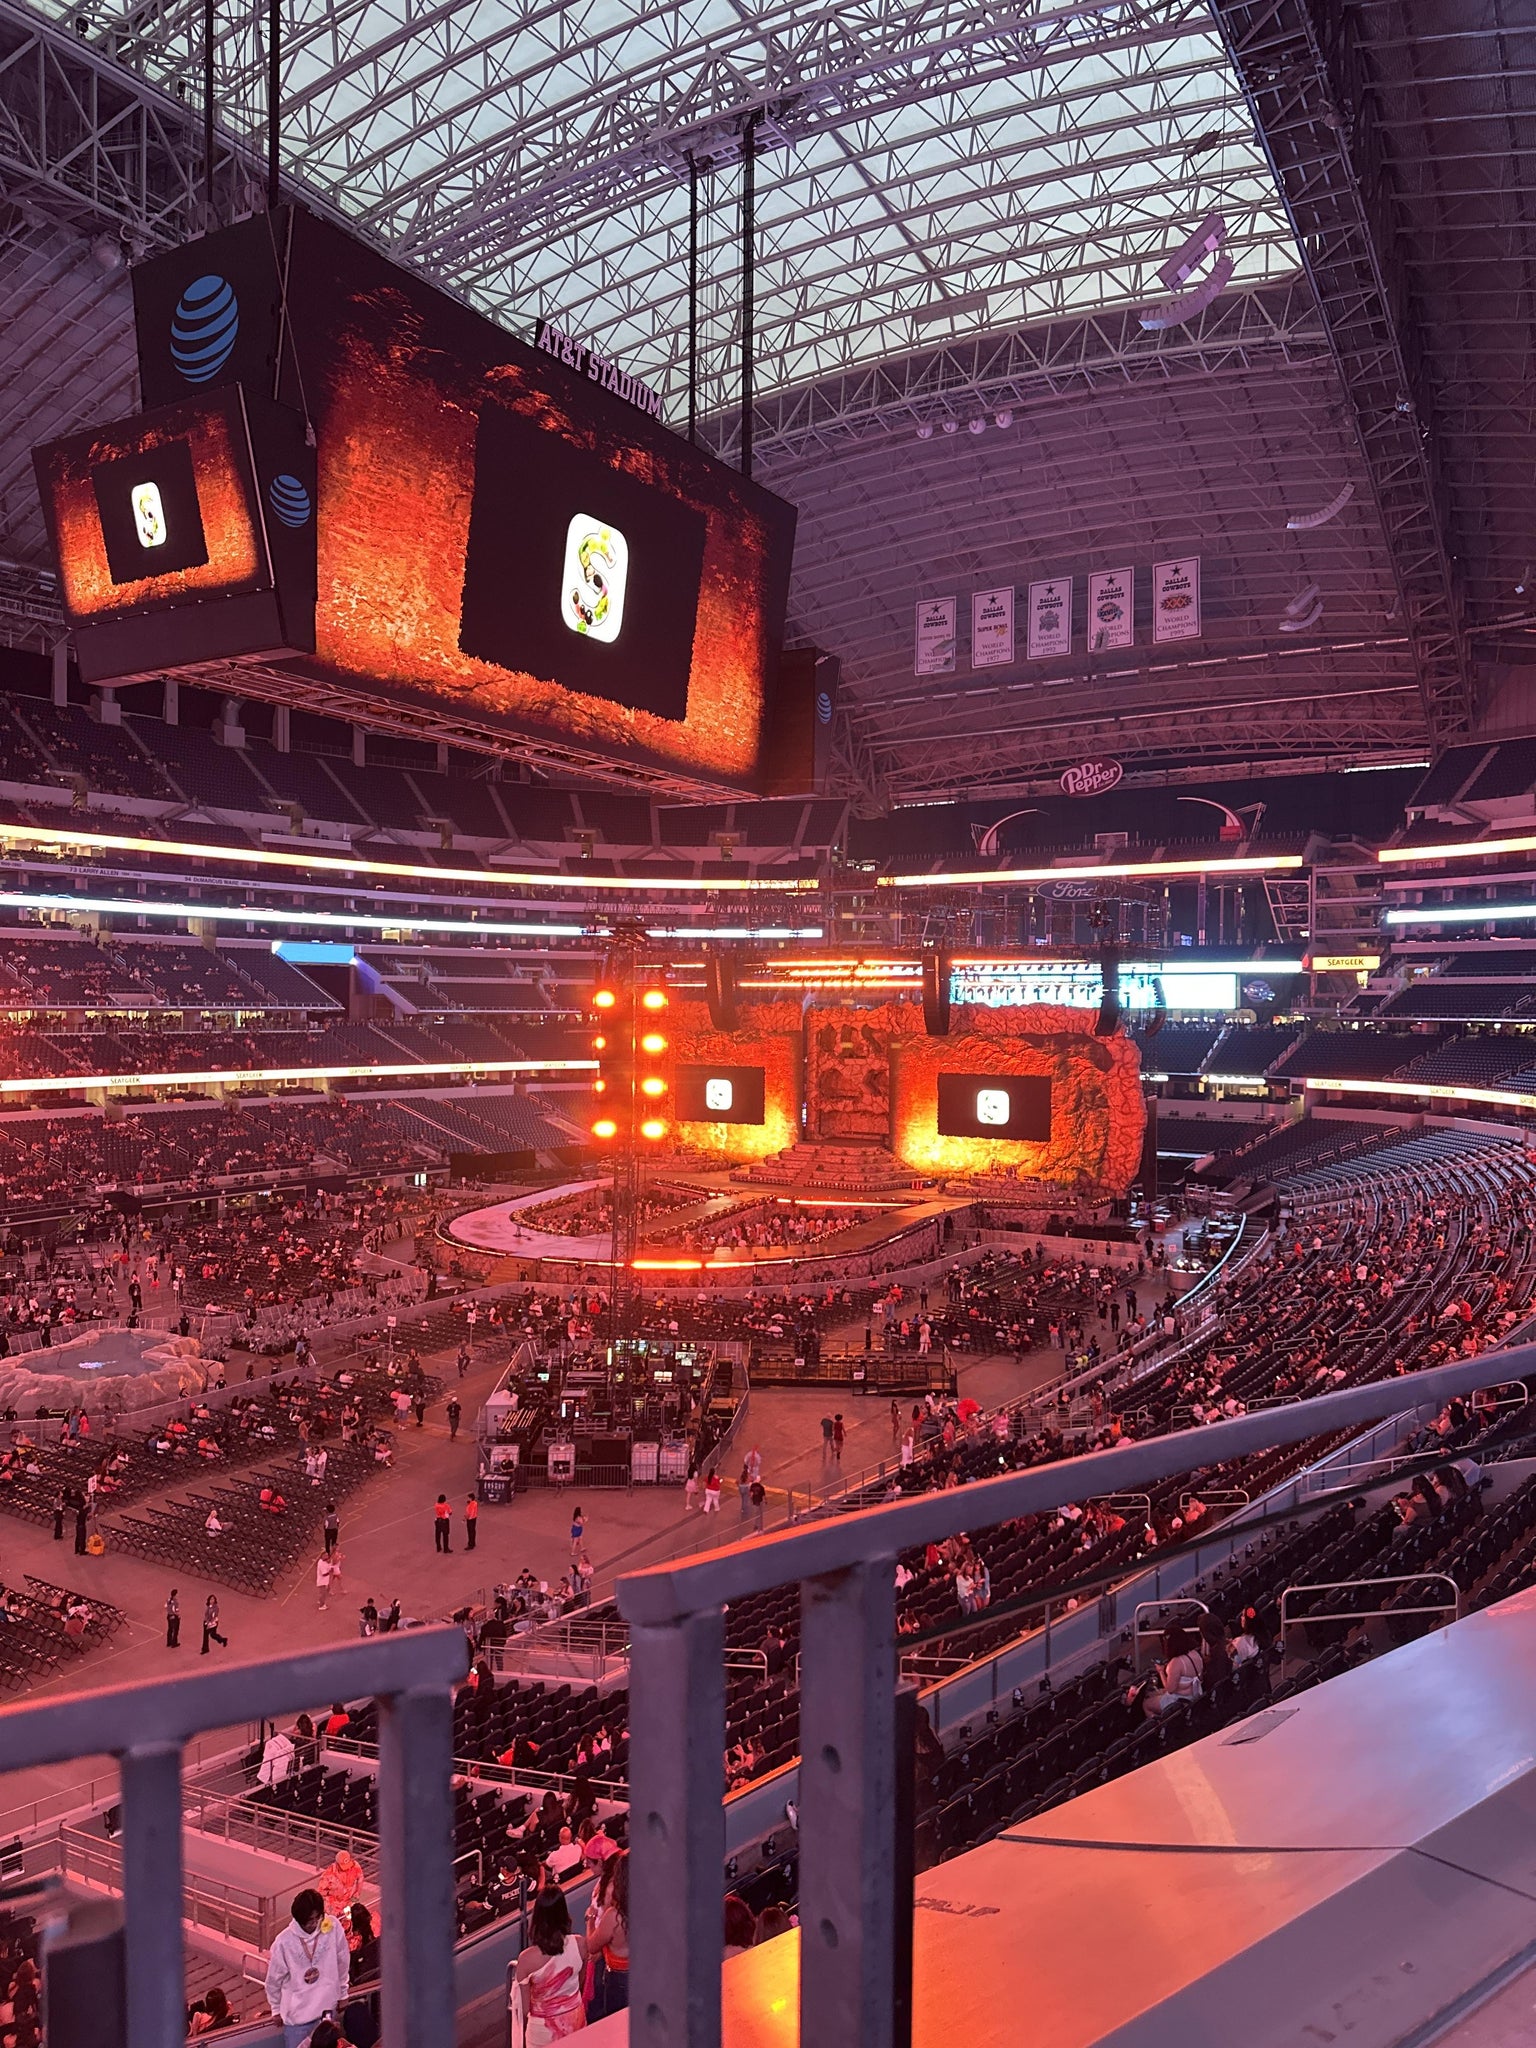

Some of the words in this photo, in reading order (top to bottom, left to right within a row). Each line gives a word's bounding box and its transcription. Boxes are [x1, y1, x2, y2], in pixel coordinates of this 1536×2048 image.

[538, 323, 586, 371] AT&T
[587, 352, 662, 419] STADIUM
[1165, 576, 1188, 585] DALLAS
[1100, 586, 1122, 595] DALLAS
[1162, 583, 1191, 592] COWBOYS
[1039, 596, 1061, 604] DALLAS
[1097, 592, 1125, 602] COWBOYS
[982, 605, 1004, 614] DALLAS
[1037, 602, 1063, 610] COWBOYS
[925, 614, 946, 622] DALLAS
[980, 611, 1006, 620] COWBOYS
[1164, 615, 1190, 623] WORLD
[923, 620, 948, 628] COWBOYS
[1098, 624, 1123, 632] WORLD
[1157, 621, 1197, 632] CHAMPIONS
[977, 625, 992, 633] SUPER
[1038, 633, 1061, 641] WORLD
[982, 641, 1004, 650] WORLD
[1031, 640, 1068, 649] CHAMPIONS
[976, 647, 1011, 657] CHAMPIONS
[1080, 762, 1103, 779] Dr
[1066, 767, 1118, 794] Pepper
[1327, 958, 1364, 966] SEATGEEK
[110, 1076, 141, 1085] SEATGEEK
